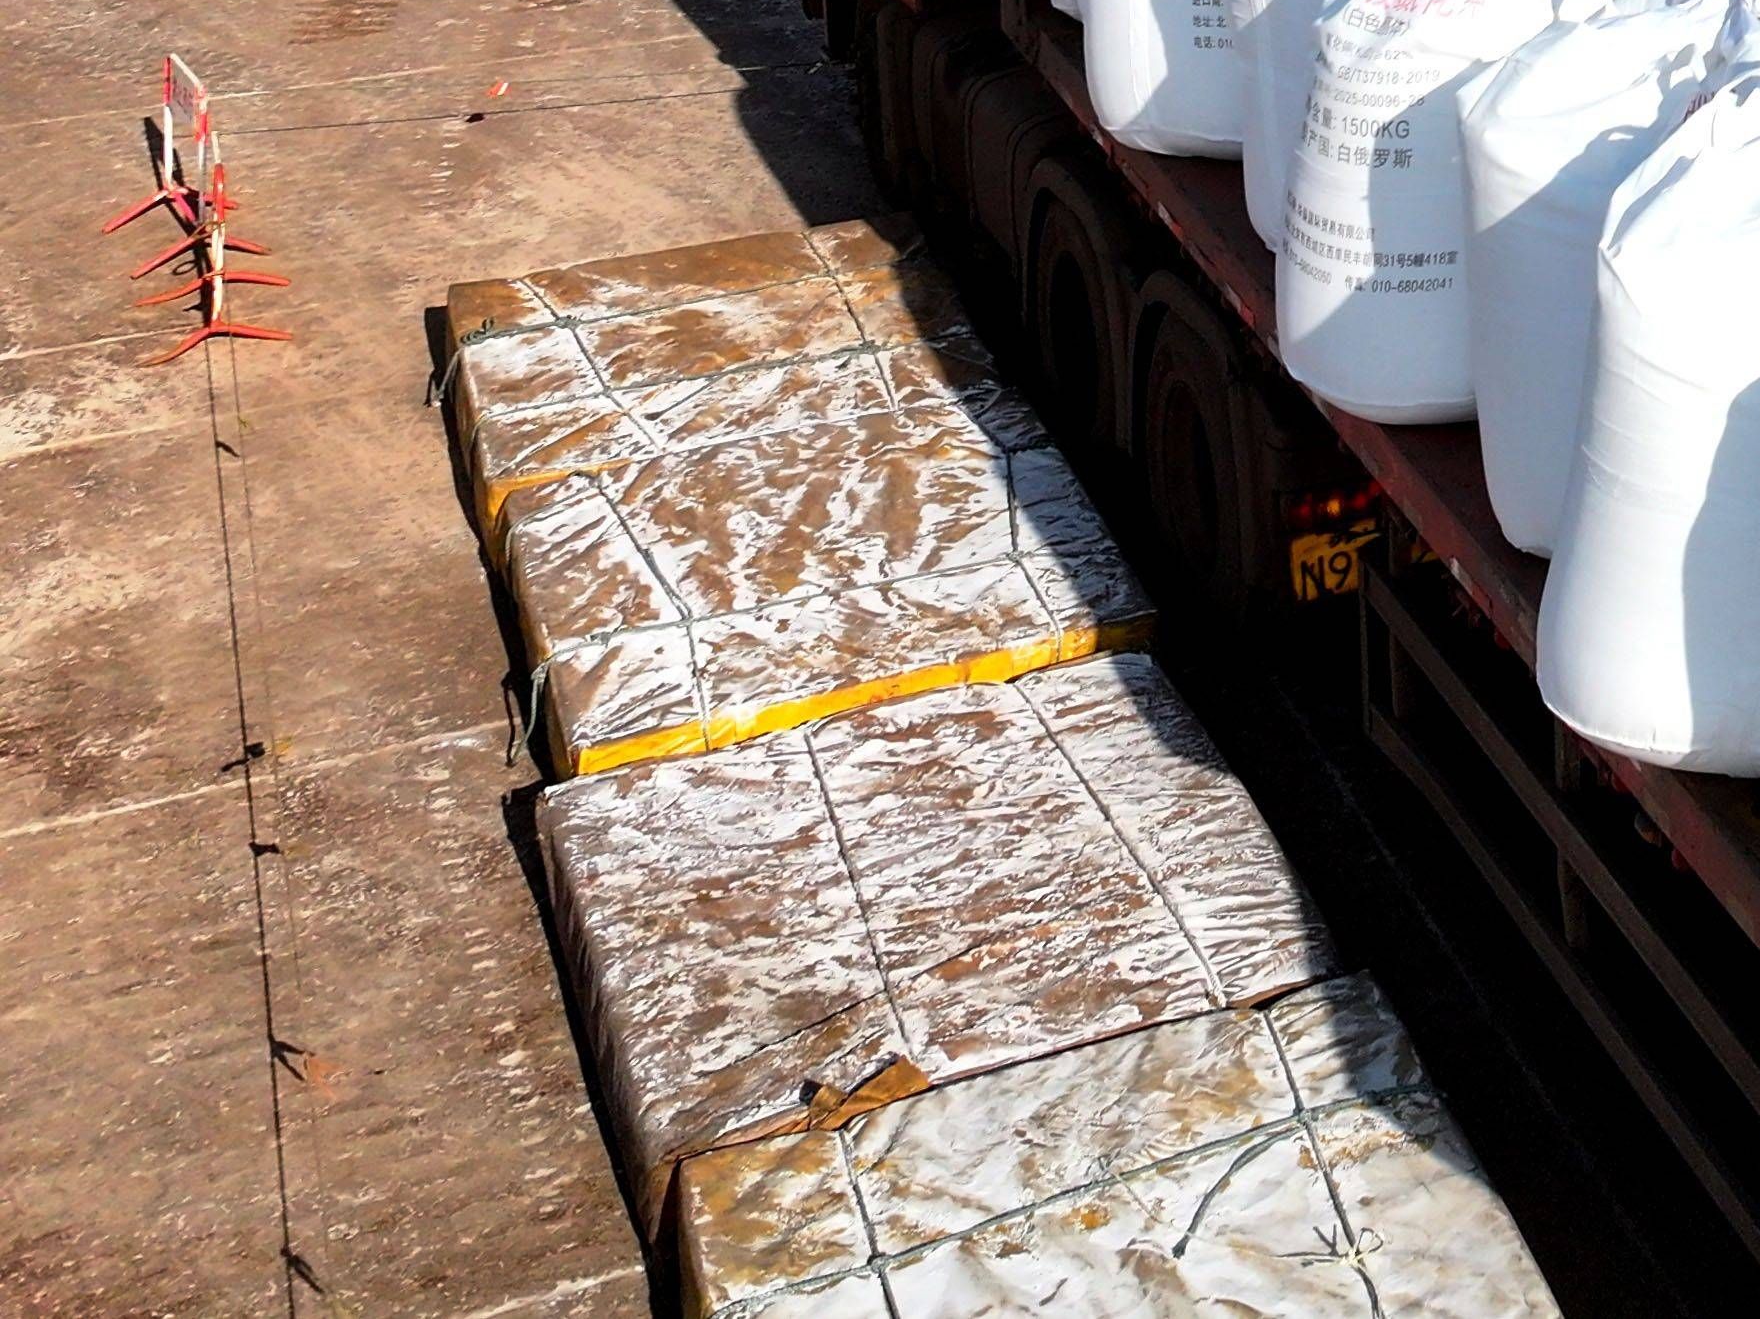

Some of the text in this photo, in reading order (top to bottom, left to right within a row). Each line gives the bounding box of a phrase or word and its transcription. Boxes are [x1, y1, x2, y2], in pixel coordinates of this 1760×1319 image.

[1342, 116, 1410, 140] 1500KG
[1337, 143, 1413, 169] 白俄罗斯
[1372, 277, 1454, 293] 010-68042041
